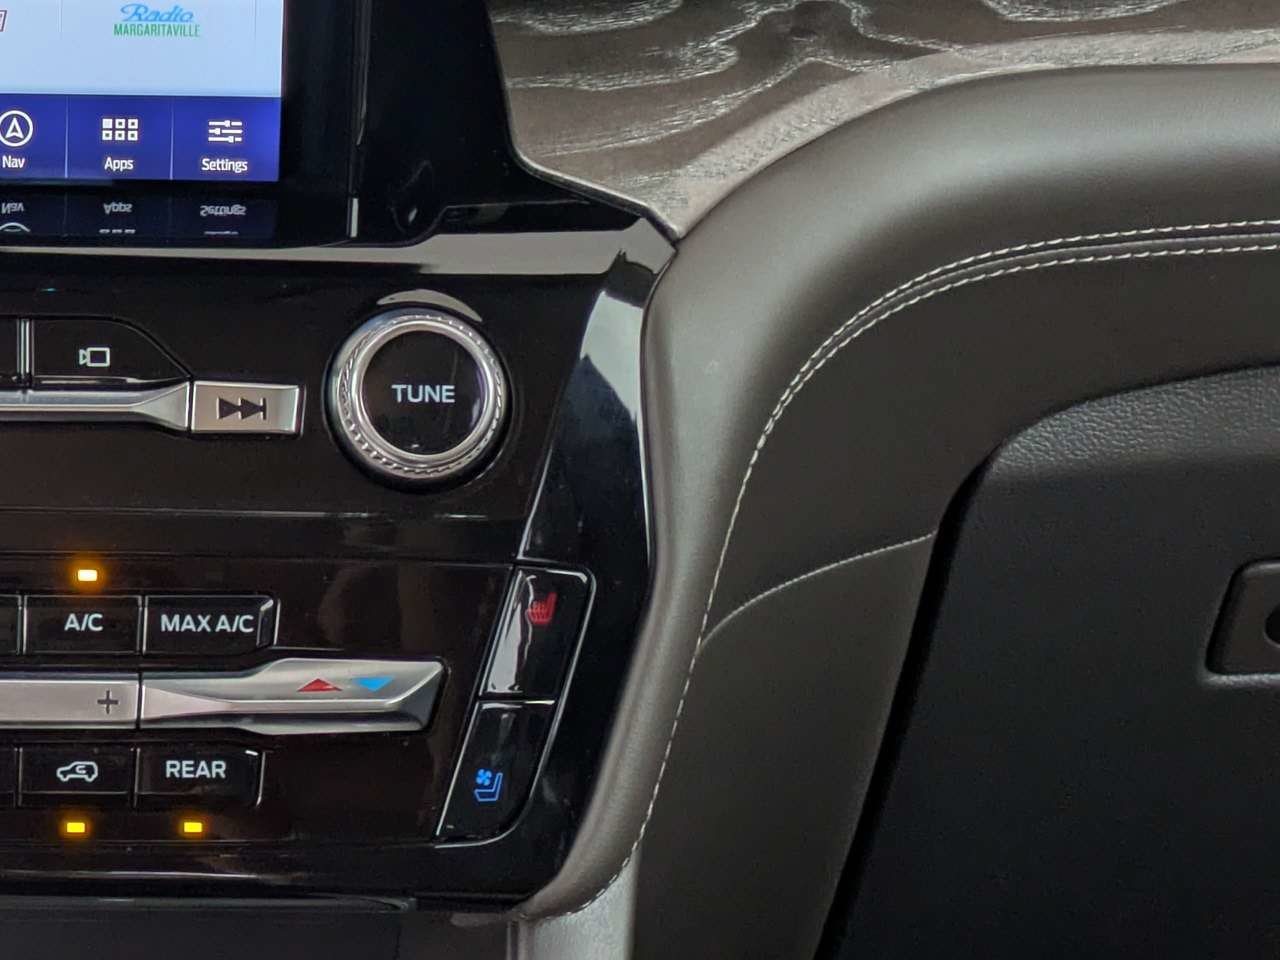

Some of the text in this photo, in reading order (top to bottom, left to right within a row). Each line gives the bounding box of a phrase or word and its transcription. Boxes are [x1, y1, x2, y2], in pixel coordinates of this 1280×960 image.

[120, 3, 194, 22] Radio
[114, 24, 199, 37] MARGARITAVILLE
[3, 155, 25, 168] Nav
[105, 157, 133, 171] Apps
[202, 158, 248, 173] Settings
[392, 385, 455, 403] TUNE
[65, 614, 103, 631] A/C
[161, 614, 253, 632] MAX A/C
[166, 760, 226, 778] REAR
